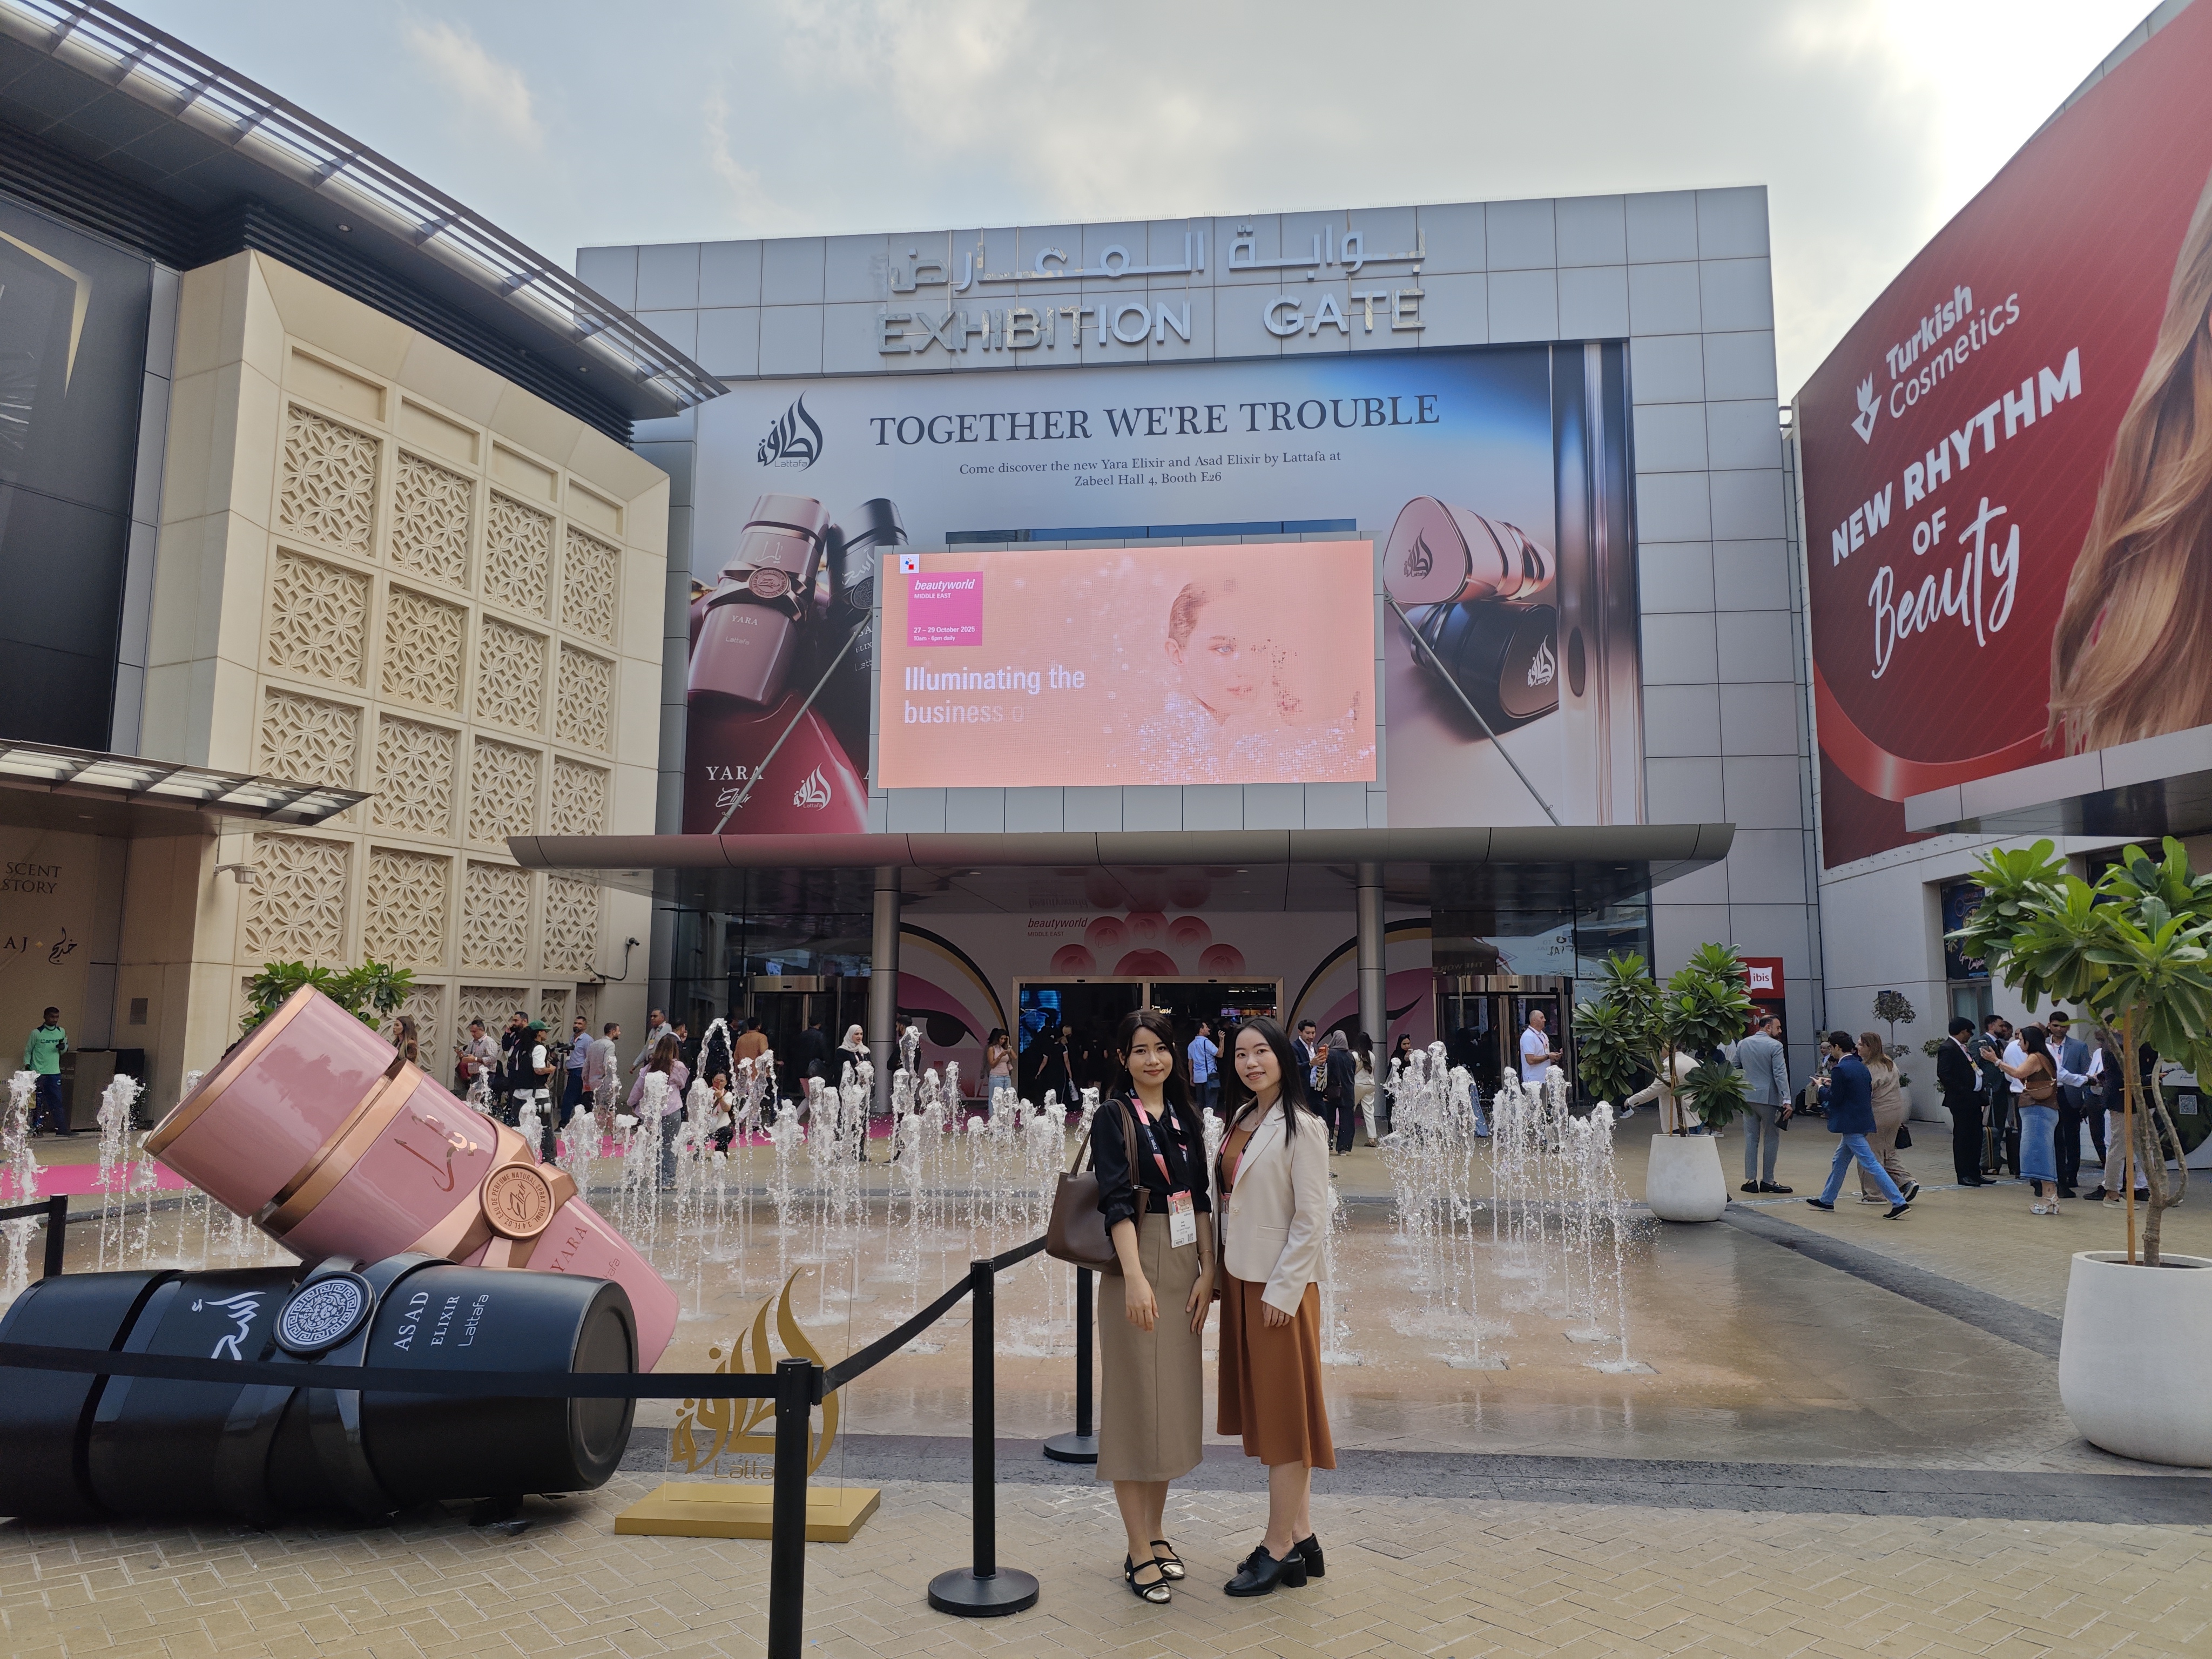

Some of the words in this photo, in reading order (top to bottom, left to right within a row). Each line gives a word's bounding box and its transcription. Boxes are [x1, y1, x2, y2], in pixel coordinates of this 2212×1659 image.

[889, 231, 1204, 293] المعارض
[1229, 224, 1426, 281] بوابة
[877, 300, 1191, 355] EXHIBITION
[1263, 288, 1426, 338] GATE
[1885, 284, 1973, 380] Turkish
[1890, 292, 2021, 419] Cosmetics
[869, 410, 1092, 446] TOGETHER
[1103, 404, 1228, 437] WE'RE
[1239, 394, 1440, 433] TROUBLE
[774, 459, 808, 468] Lattafa
[960, 463, 995, 475] Come
[998, 461, 1047, 474] discover
[1050, 460, 1070, 471] the
[1073, 462, 1098, 471] new
[1101, 458, 1128, 470] Yara
[1131, 457, 1165, 469] Elixir
[1168, 456, 1191, 468] and
[1194, 455, 1223, 467] Asad
[1226, 453, 1261, 466] Elixir
[1263, 453, 1280, 467] by
[1282, 451, 1326, 463] Lattafa
[1329, 451, 1341, 461] at
[1831, 481, 1893, 567] NEW
[1903, 346, 2082, 511] RHYTHM
[1075, 475, 1114, 487] Zabeel
[1117, 474, 1145, 485] Hall
[1148, 477, 1157, 486] 4,
[1161, 472, 1197, 484] Booth
[1201, 471, 1222, 482] E26
[1912, 506, 1946, 556] OF
[915, 579, 975, 591] beautyworld
[1868, 496, 2020, 679] Beauty
[732, 615, 758, 625] YARA
[726, 636, 750, 645] Lattafa
[855, 642, 873, 653] ELIX
[905, 666, 1041, 695] Illuminating
[1048, 664, 1085, 689] the
[903, 699, 1004, 724] business
[706, 766, 764, 780] YARA
[716, 787, 752, 808] Eliir
[6, 862, 62, 878] SCENT
[1, 879, 58, 894] STORY
[1028, 918, 1088, 929] beautyworld
[1753, 973, 1770, 982] ibis
[491, 1173, 510, 1196] PERFUME
[511, 1172, 536, 1185] NATURAL
[507, 1181, 531, 1220] Elixir
[535, 1184, 547, 1204] SPRAY
[493, 1208, 504, 1219] EAU
[550, 1227, 588, 1272] YARA
[602, 1258, 621, 1279] tafa
[394, 1292, 429, 1351] ASAD
[430, 1295, 460, 1347] ELIXIR
[457, 1293, 489, 1346] Lattafa
[714, 1459, 774, 1479] Latta
